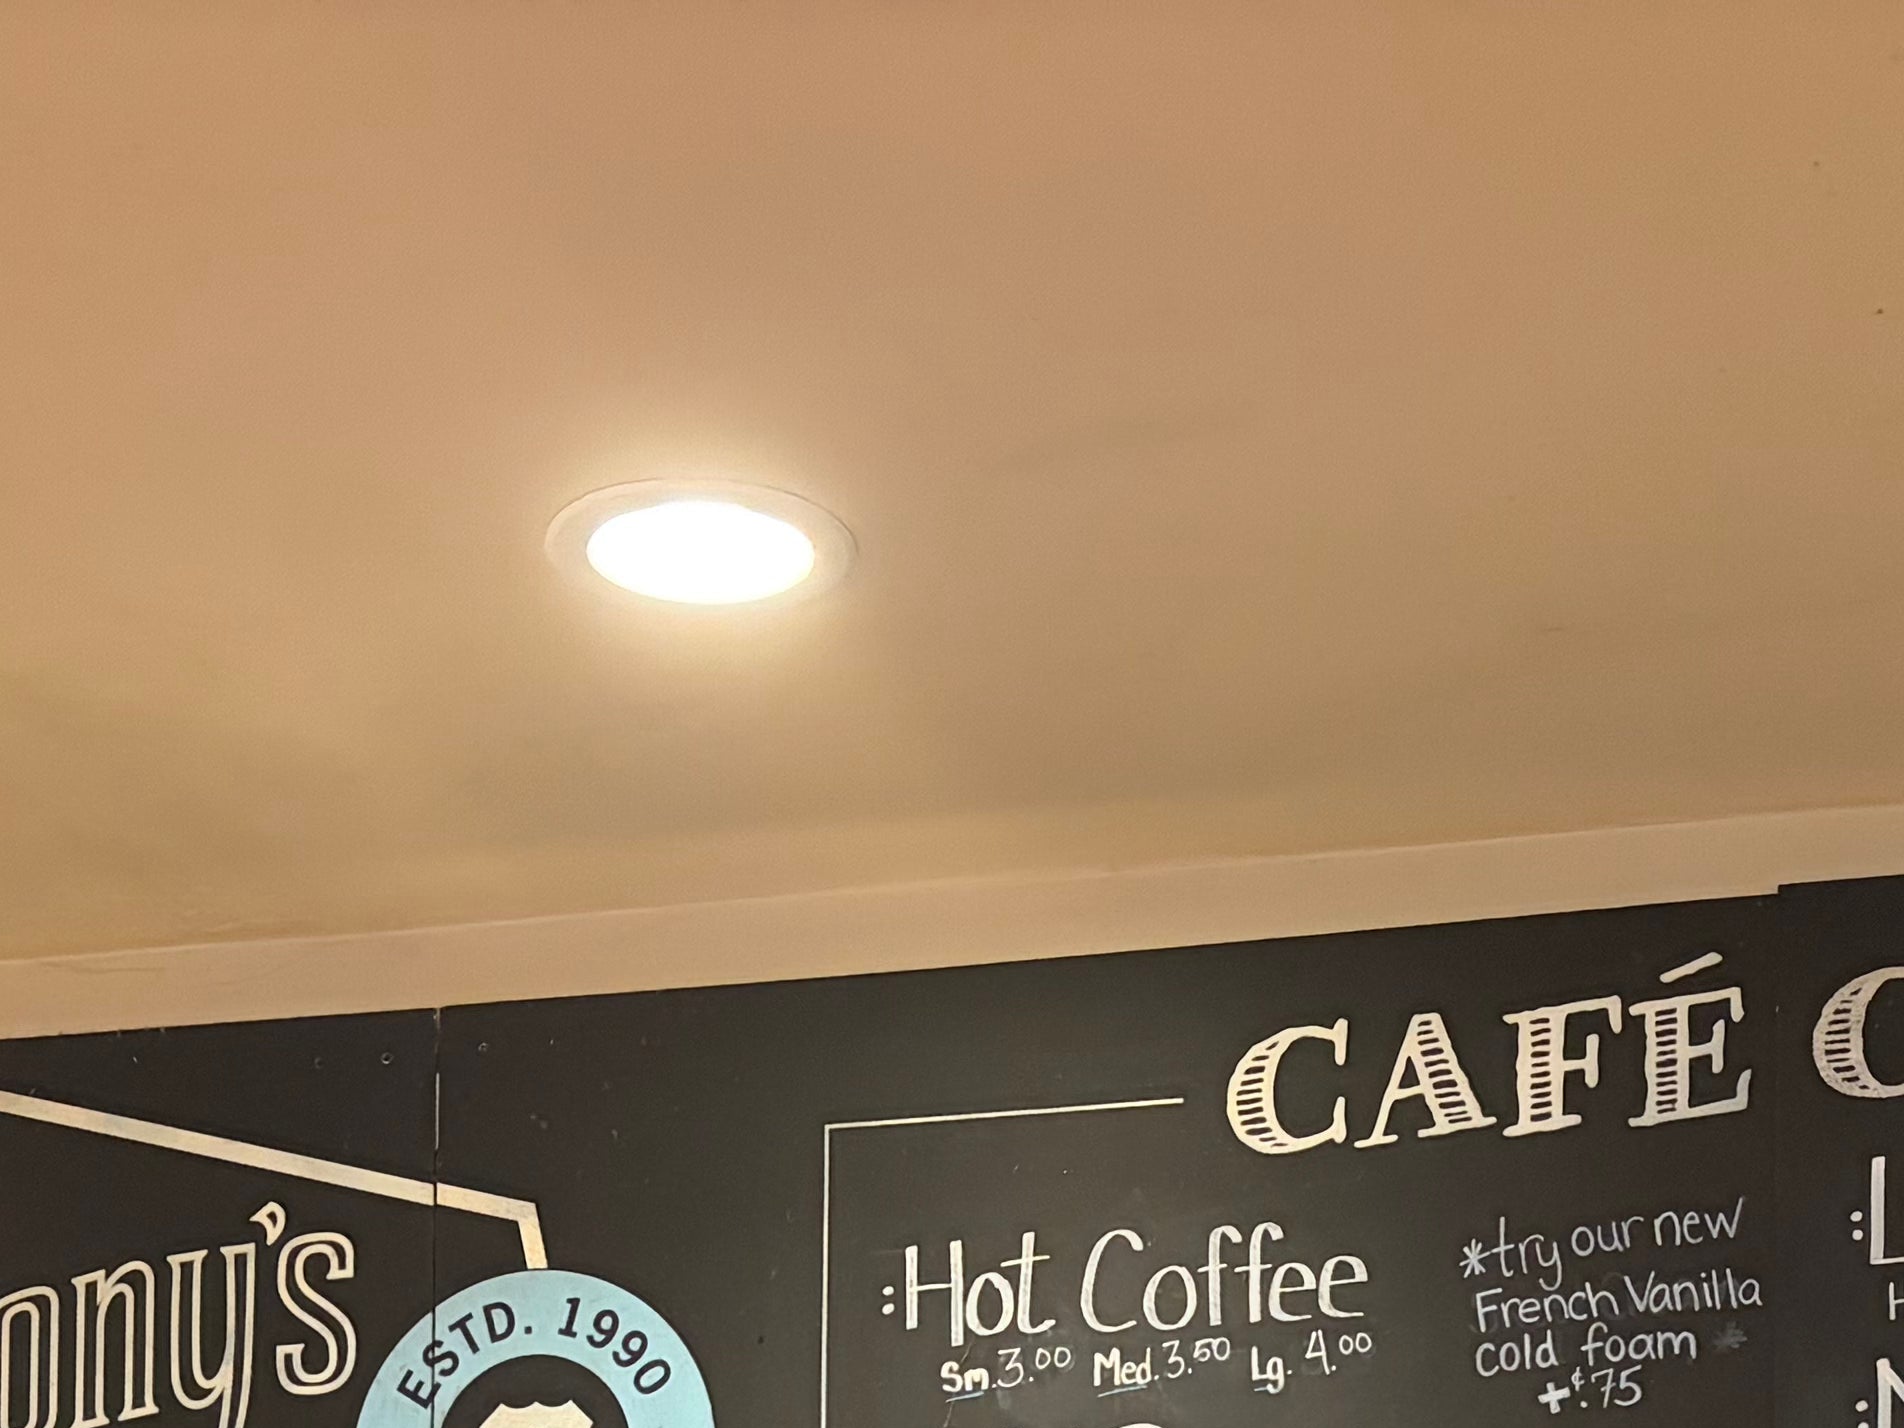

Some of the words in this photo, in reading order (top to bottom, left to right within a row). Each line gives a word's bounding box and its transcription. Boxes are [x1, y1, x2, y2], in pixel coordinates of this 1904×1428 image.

[1226, 951, 1752, 1155] CAFÉ
[1571, 1215, 1644, 1256] our
[1654, 1196, 1744, 1246] new
[905, 1232, 1056, 1346] Hot
[1081, 1222, 1367, 1332] Coffee
[1475, 1281, 1620, 1332] French
[1622, 1268, 1763, 1314] Vanilla
[396, 1296, 536, 1411] ESTD.
[555, 1296, 673, 1398] 1990
[1475, 1328, 1559, 1377] cold
[1580, 1322, 1697, 1367] foam
